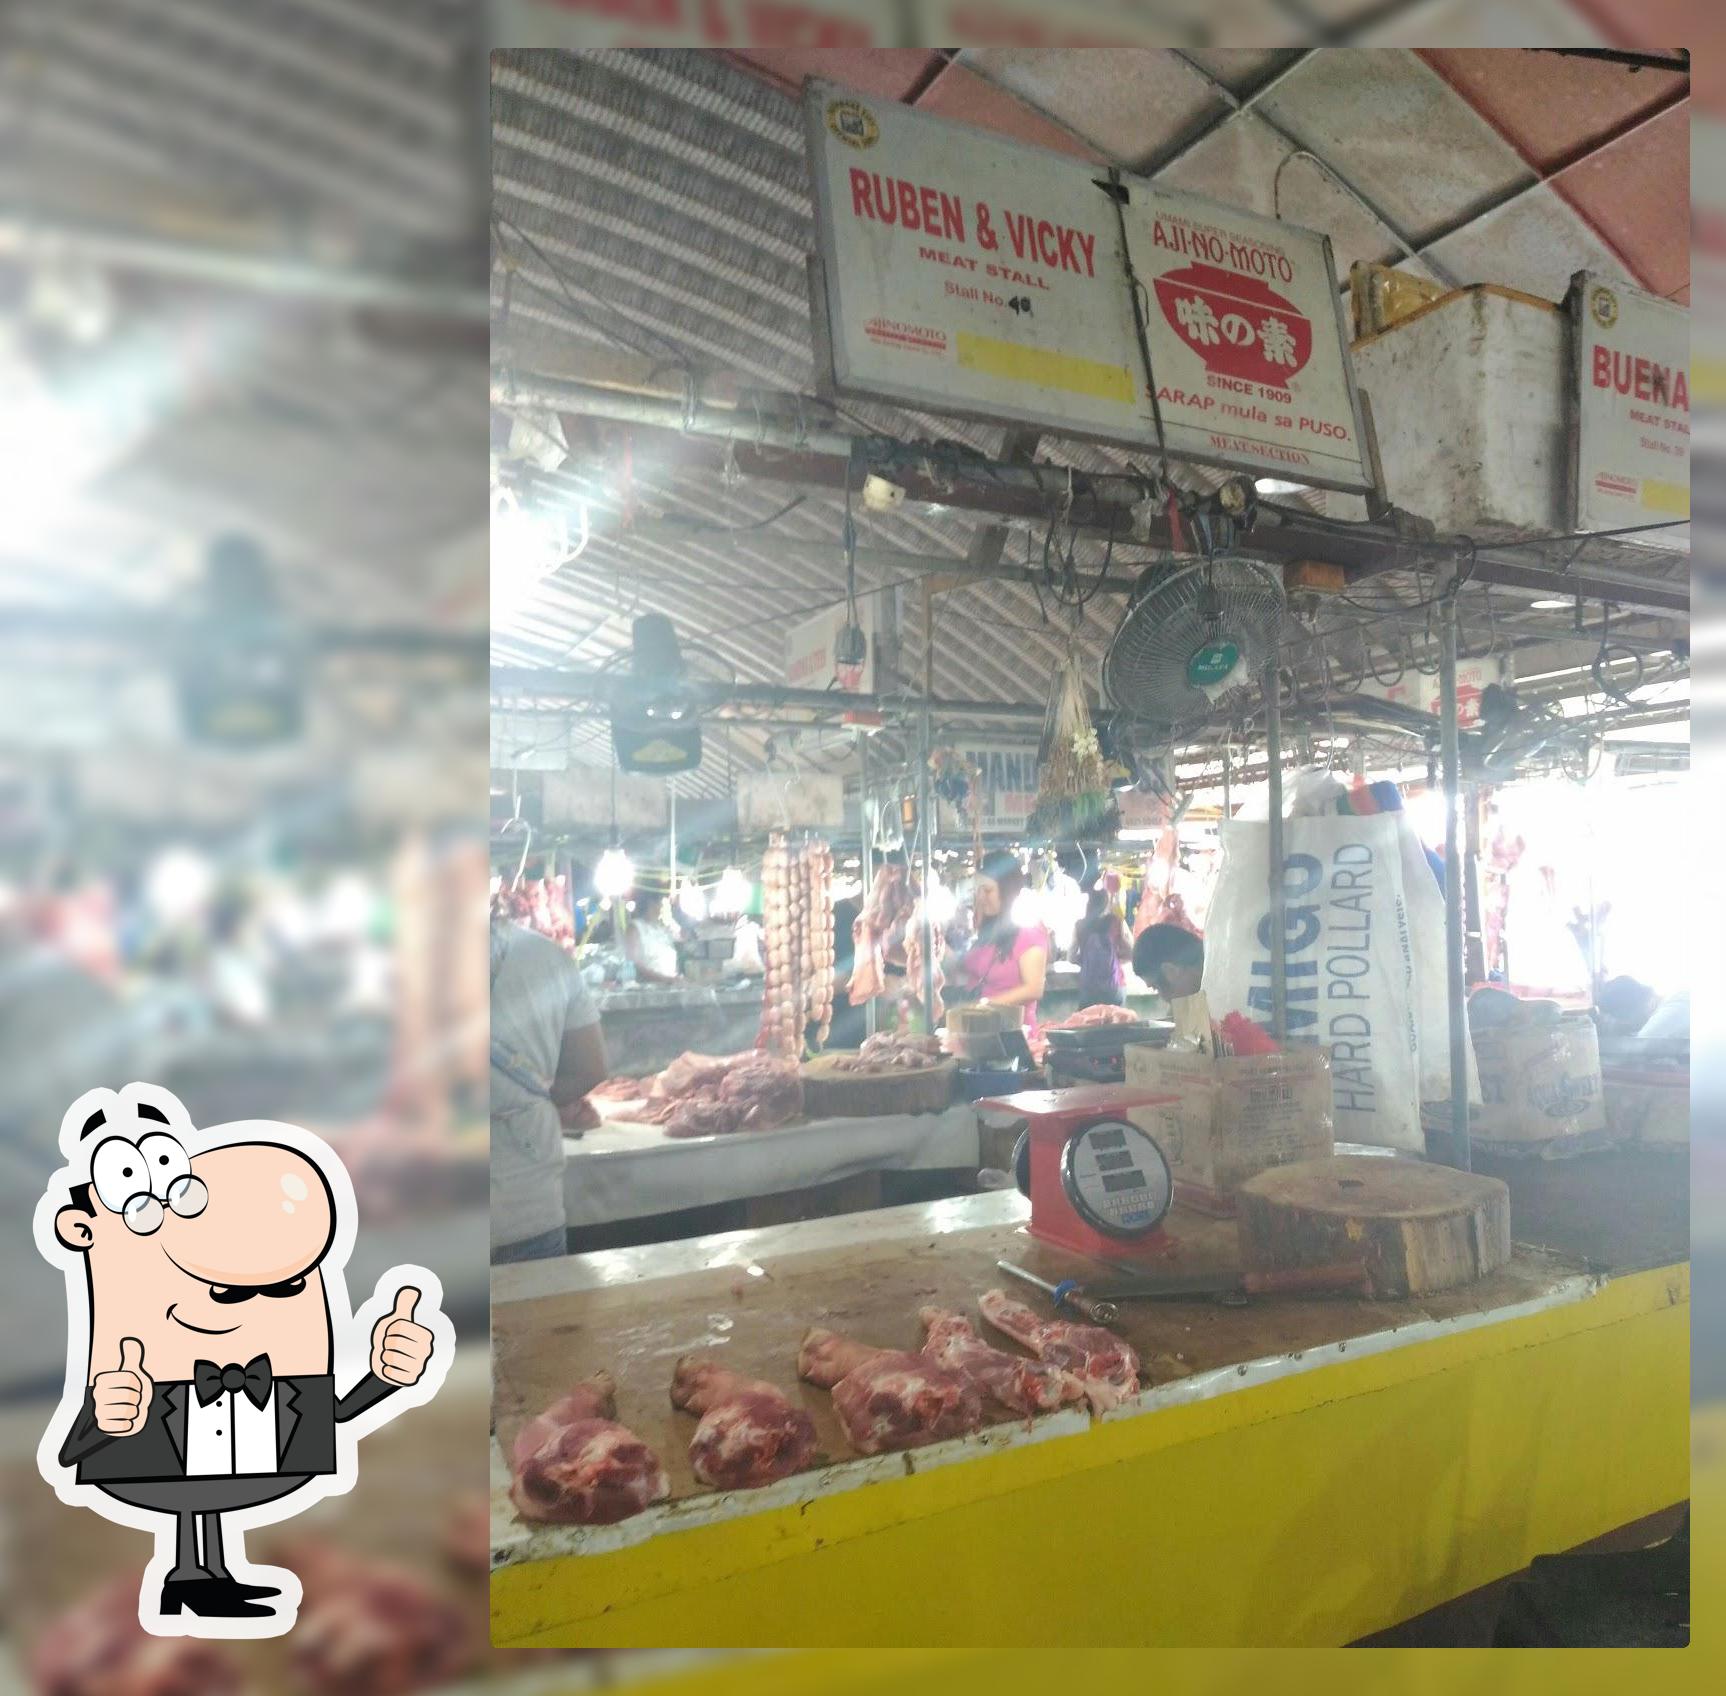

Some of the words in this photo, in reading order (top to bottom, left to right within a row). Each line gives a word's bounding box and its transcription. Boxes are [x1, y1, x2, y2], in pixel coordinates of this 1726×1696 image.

[849, 166, 965, 243] RUBEN
[976, 202, 998, 251] &
[1004, 209, 1095, 278] VICKY
[919, 246, 978, 271] MEAT
[986, 263, 1051, 290] STALL
[944, 280, 978, 300] Stall
[1175, 295, 1298, 368] 味の素
[1207, 375, 1254, 396] SINCE
[1259, 386, 1292, 404] 1909
[1221, 402, 1267, 423] mula
[1274, 414, 1293, 428] sa
[1299, 417, 1351, 441] PUSO.
[1629, 409, 1661, 426] MEAT
[1209, 436, 1249, 454] MEAT
[1250, 445, 1311, 465] SECTION
[1325, 843, 1373, 1000] POLLARD
[1329, 1013, 1376, 1113] HARD
